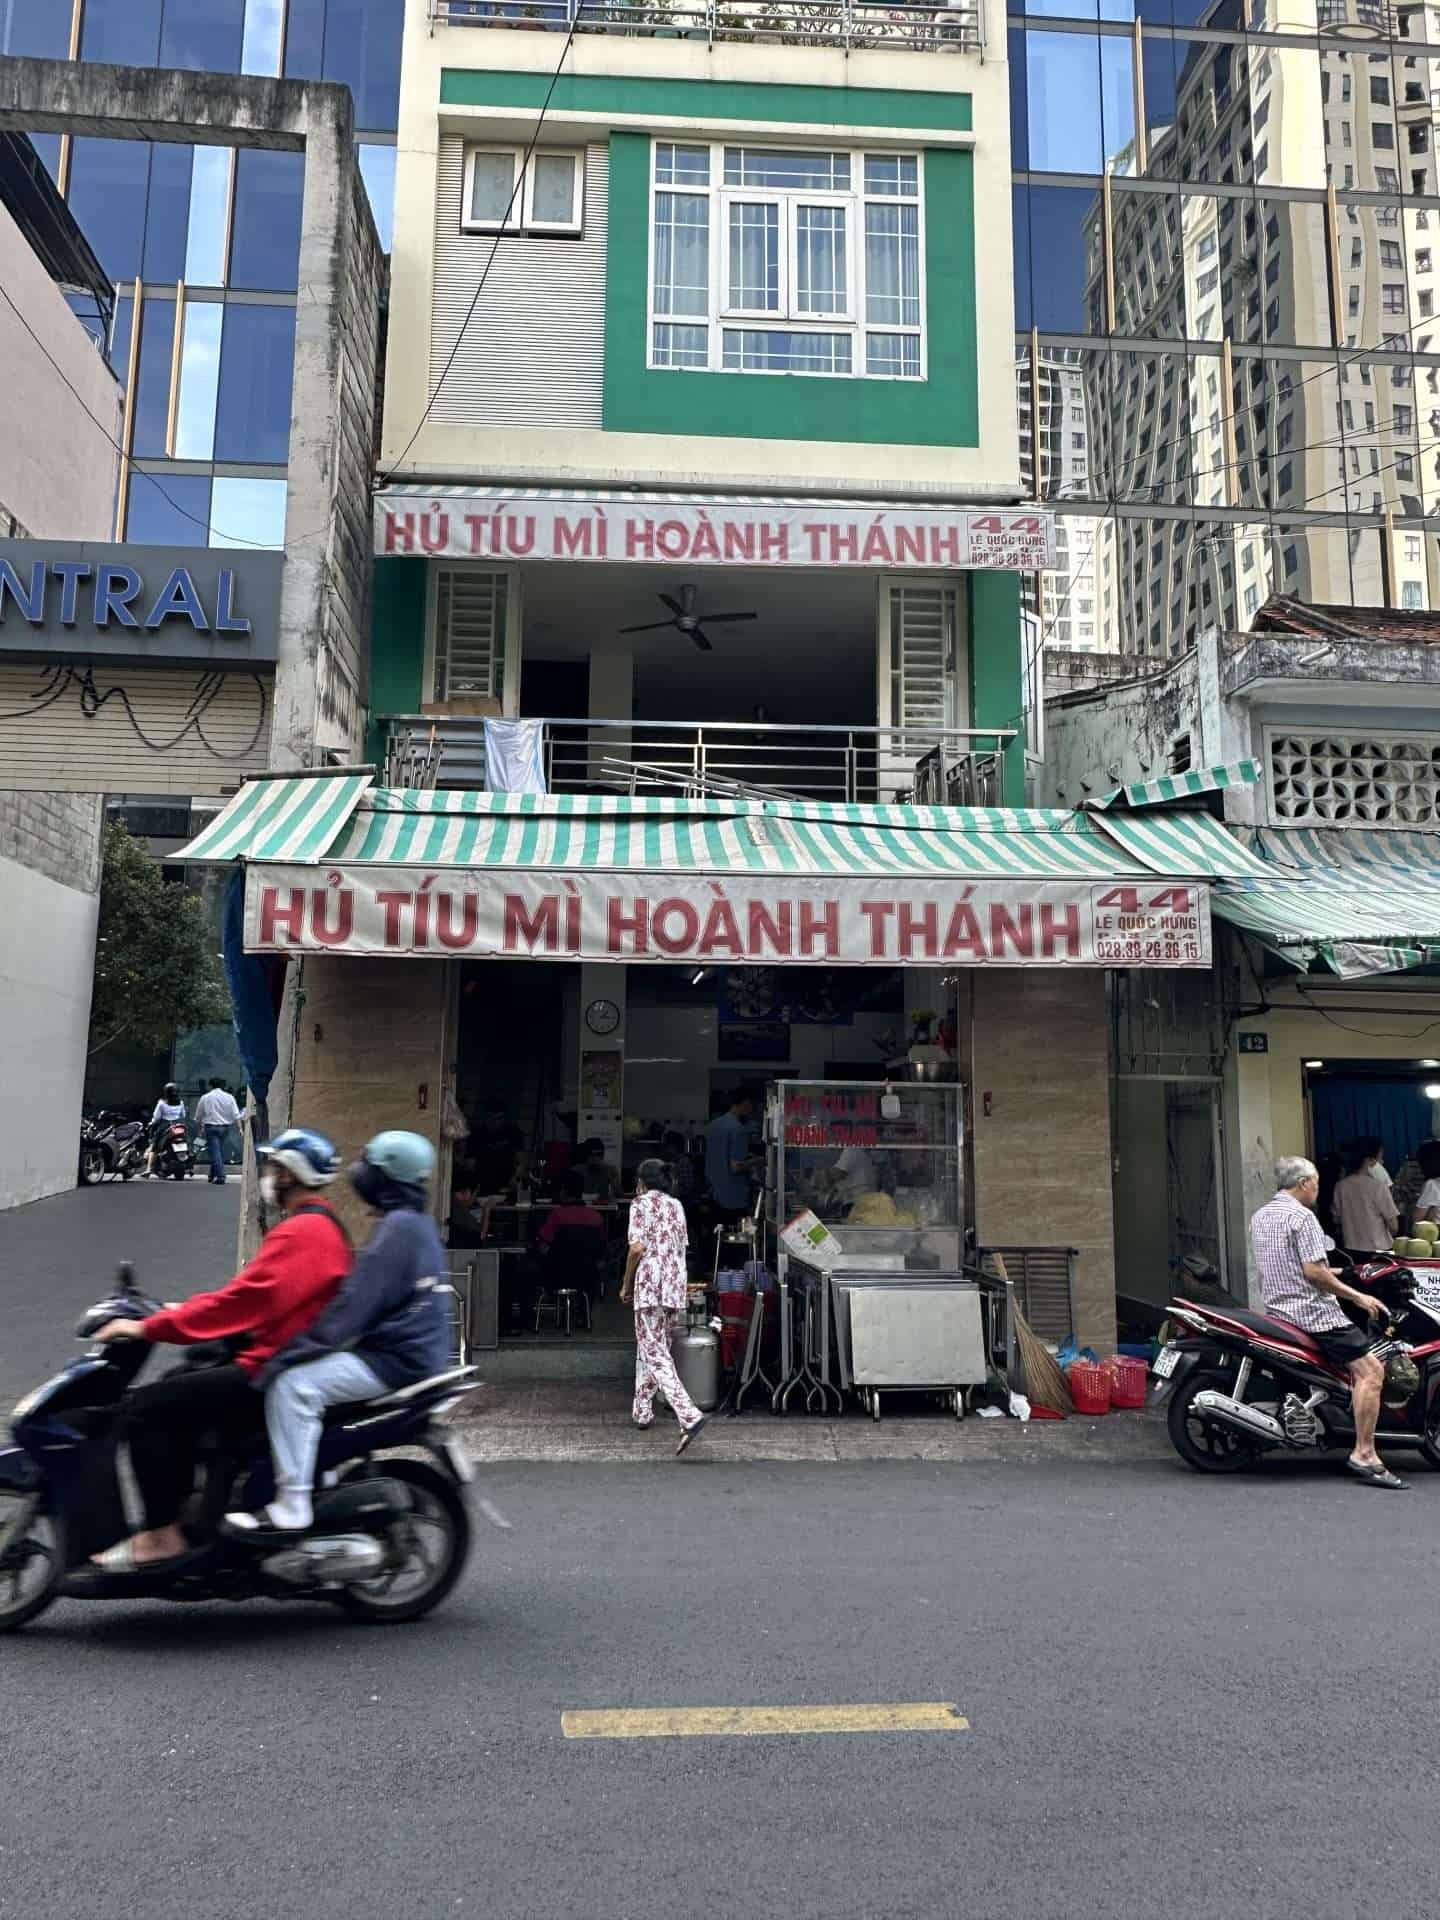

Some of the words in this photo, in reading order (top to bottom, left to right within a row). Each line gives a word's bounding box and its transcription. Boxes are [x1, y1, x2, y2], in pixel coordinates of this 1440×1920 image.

[385, 501, 449, 553] HỦ
[464, 502, 537, 555] TÍU
[553, 505, 608, 557] MÌ
[624, 508, 790, 560] HOÀNH
[802, 513, 961, 563] THÁNH
[971, 516, 1044, 534] 44
[1035, 553, 1047, 566] 15
[0, 558, 250, 631] NTRAL
[1096, 887, 1195, 913] 44
[260, 869, 355, 946] HỦ
[375, 873, 480, 949] TÍU
[503, 879, 583, 952] MÌ
[606, 880, 841, 957] HOÀNH
[860, 884, 1081, 958] THÁNH
[1095, 913, 1113, 929] LÊ
[1118, 912, 1156, 930] QUỐC
[1097, 941, 1141, 958] 028.39
[1184, 942, 1199, 958] 15
